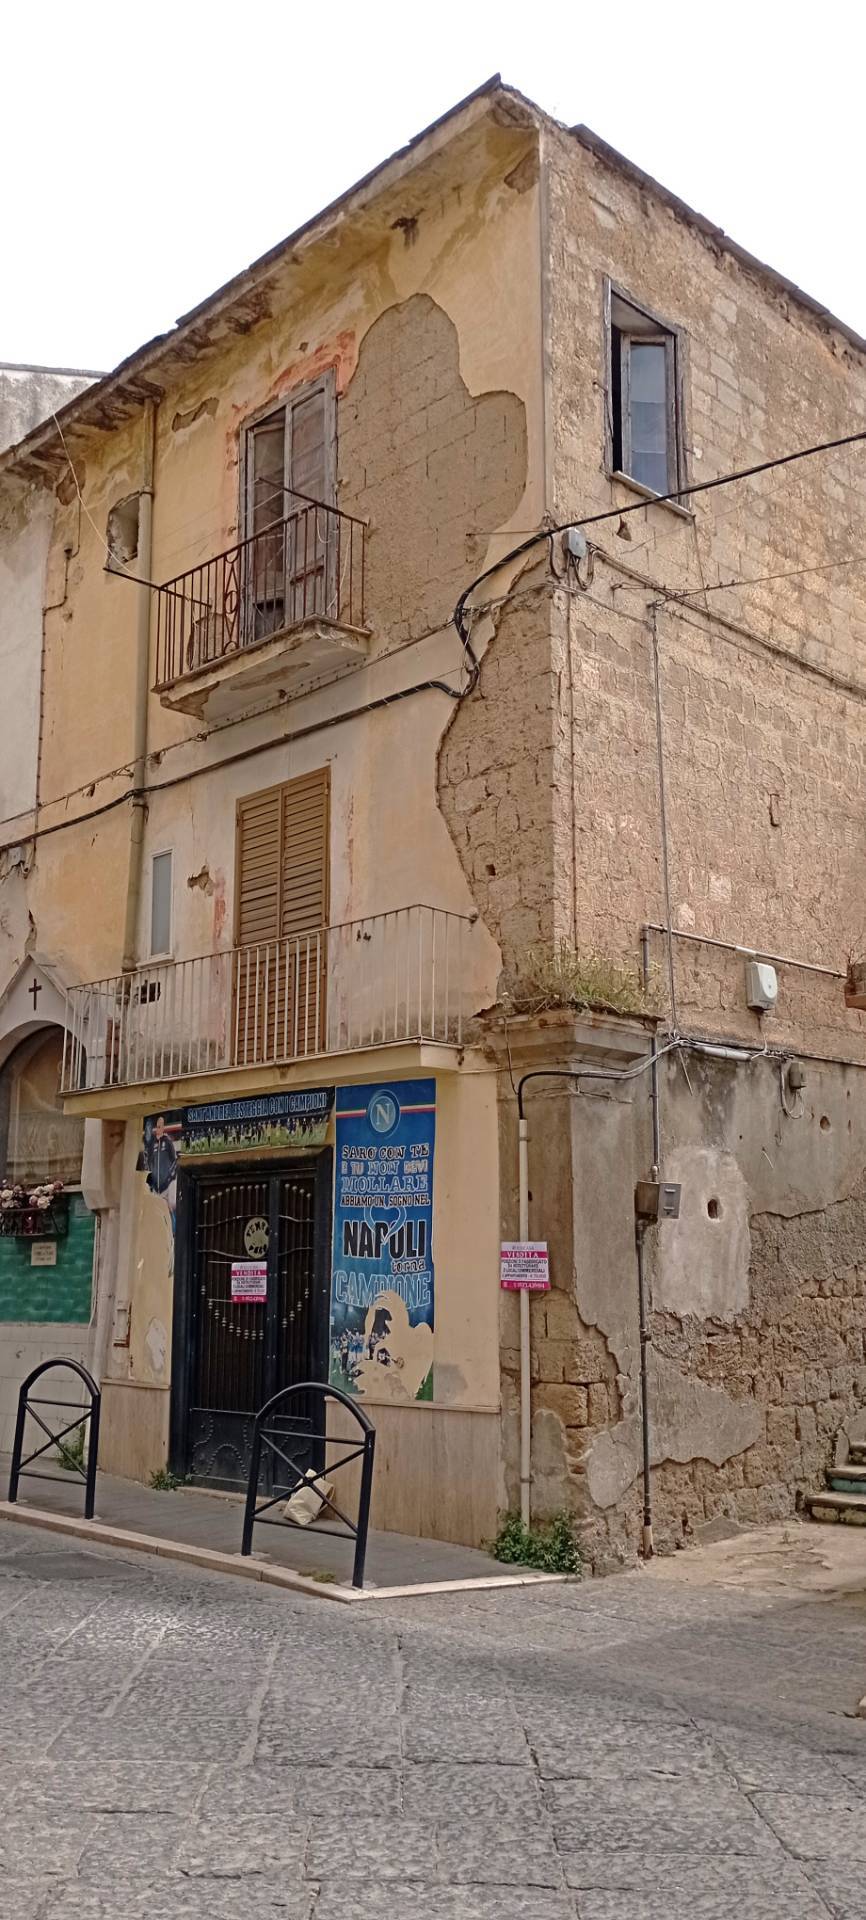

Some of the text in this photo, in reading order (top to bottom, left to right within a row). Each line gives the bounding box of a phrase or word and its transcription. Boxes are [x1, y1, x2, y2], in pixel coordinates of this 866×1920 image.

[269, 1096, 284, 1115] CON
[289, 1093, 327, 1112] CAMPIONI
[375, 1103, 391, 1126] N
[380, 1146, 406, 1160] CON
[410, 1143, 429, 1158] TE
[368, 1161, 399, 1175] NON
[404, 1160, 428, 1174] DEVI
[341, 1175, 428, 1193] MOLLARE
[340, 1195, 374, 1207] ABBIAMO
[388, 1194, 413, 1207] SOGNO
[414, 1193, 431, 1206] NEL
[343, 1220, 426, 1260] NAPOLI
[391, 1259, 426, 1273] torna
